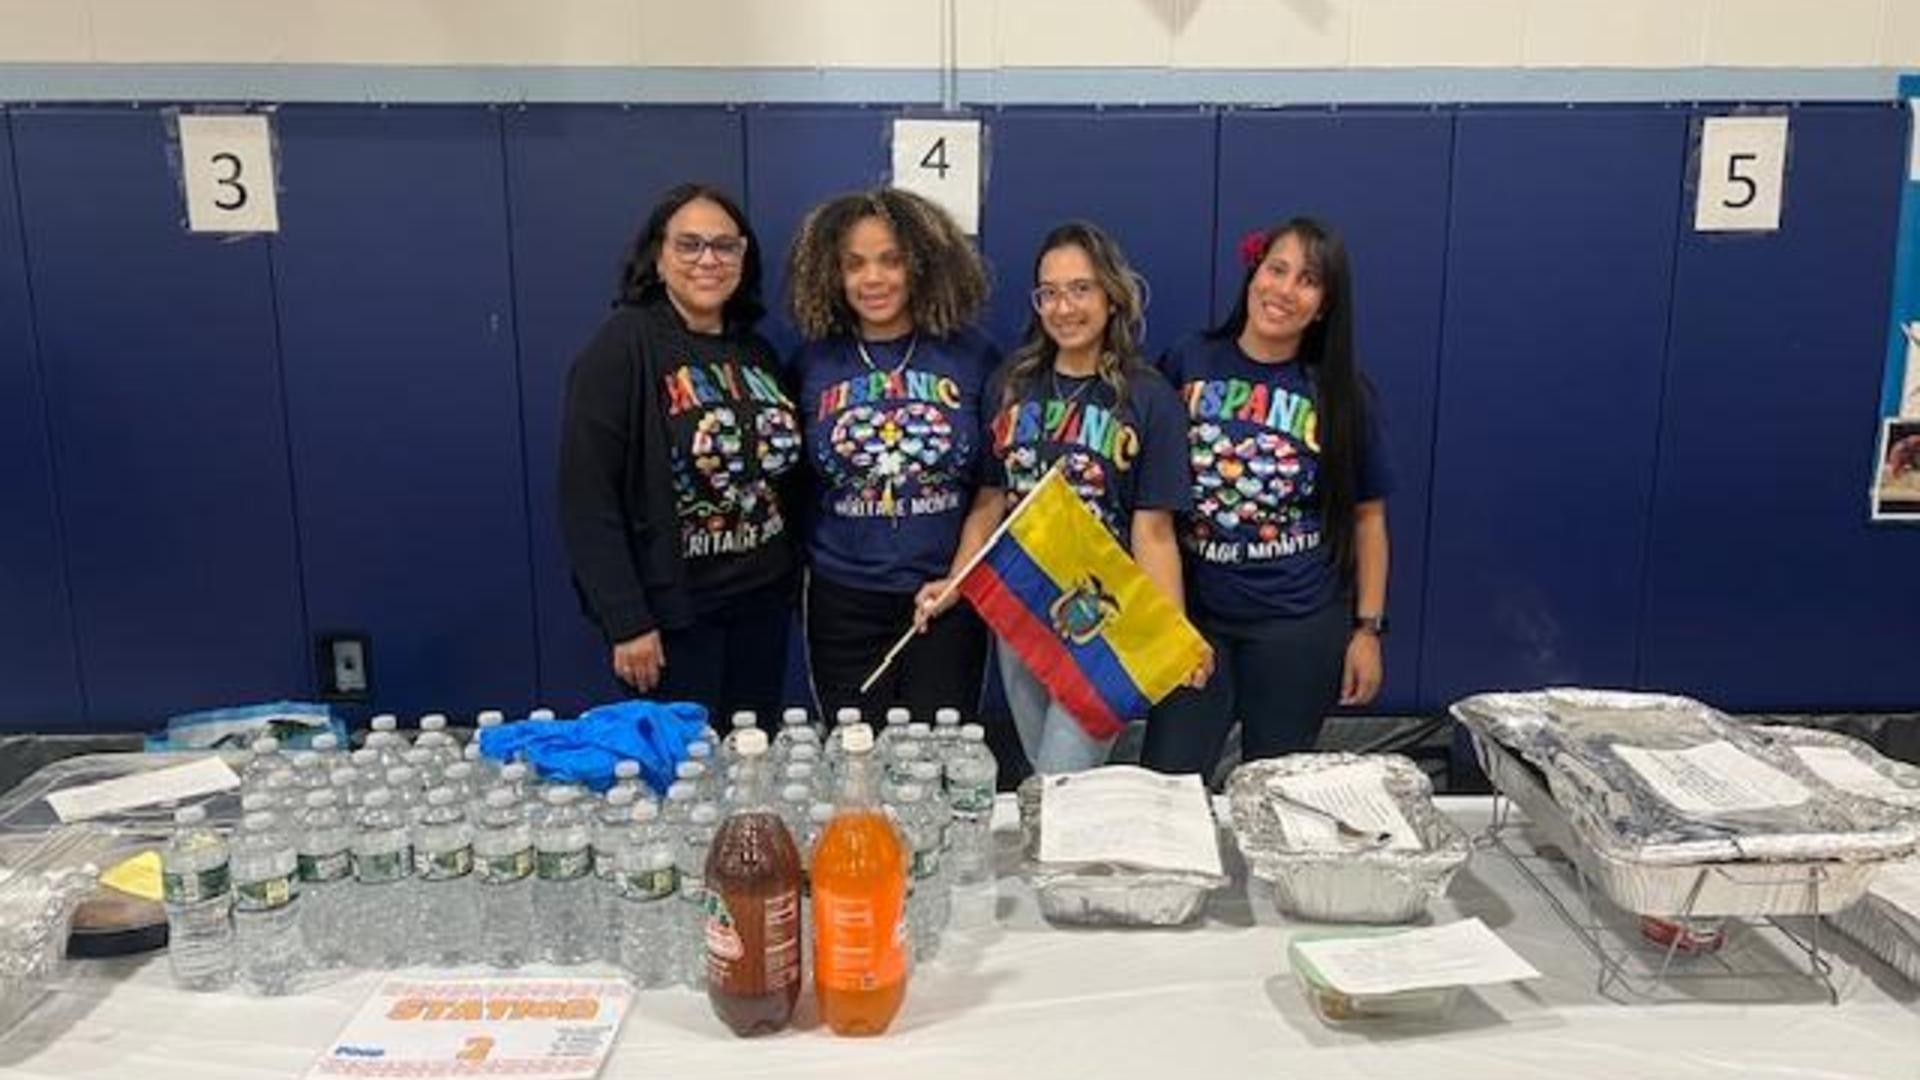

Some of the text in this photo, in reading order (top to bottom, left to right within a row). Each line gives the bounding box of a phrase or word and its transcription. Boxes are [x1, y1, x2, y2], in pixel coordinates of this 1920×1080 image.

[211, 152, 248, 211] 3
[919, 137, 950, 179] 4
[1722, 154, 1757, 209] 5
[817, 370, 961, 422] HISPANIC
